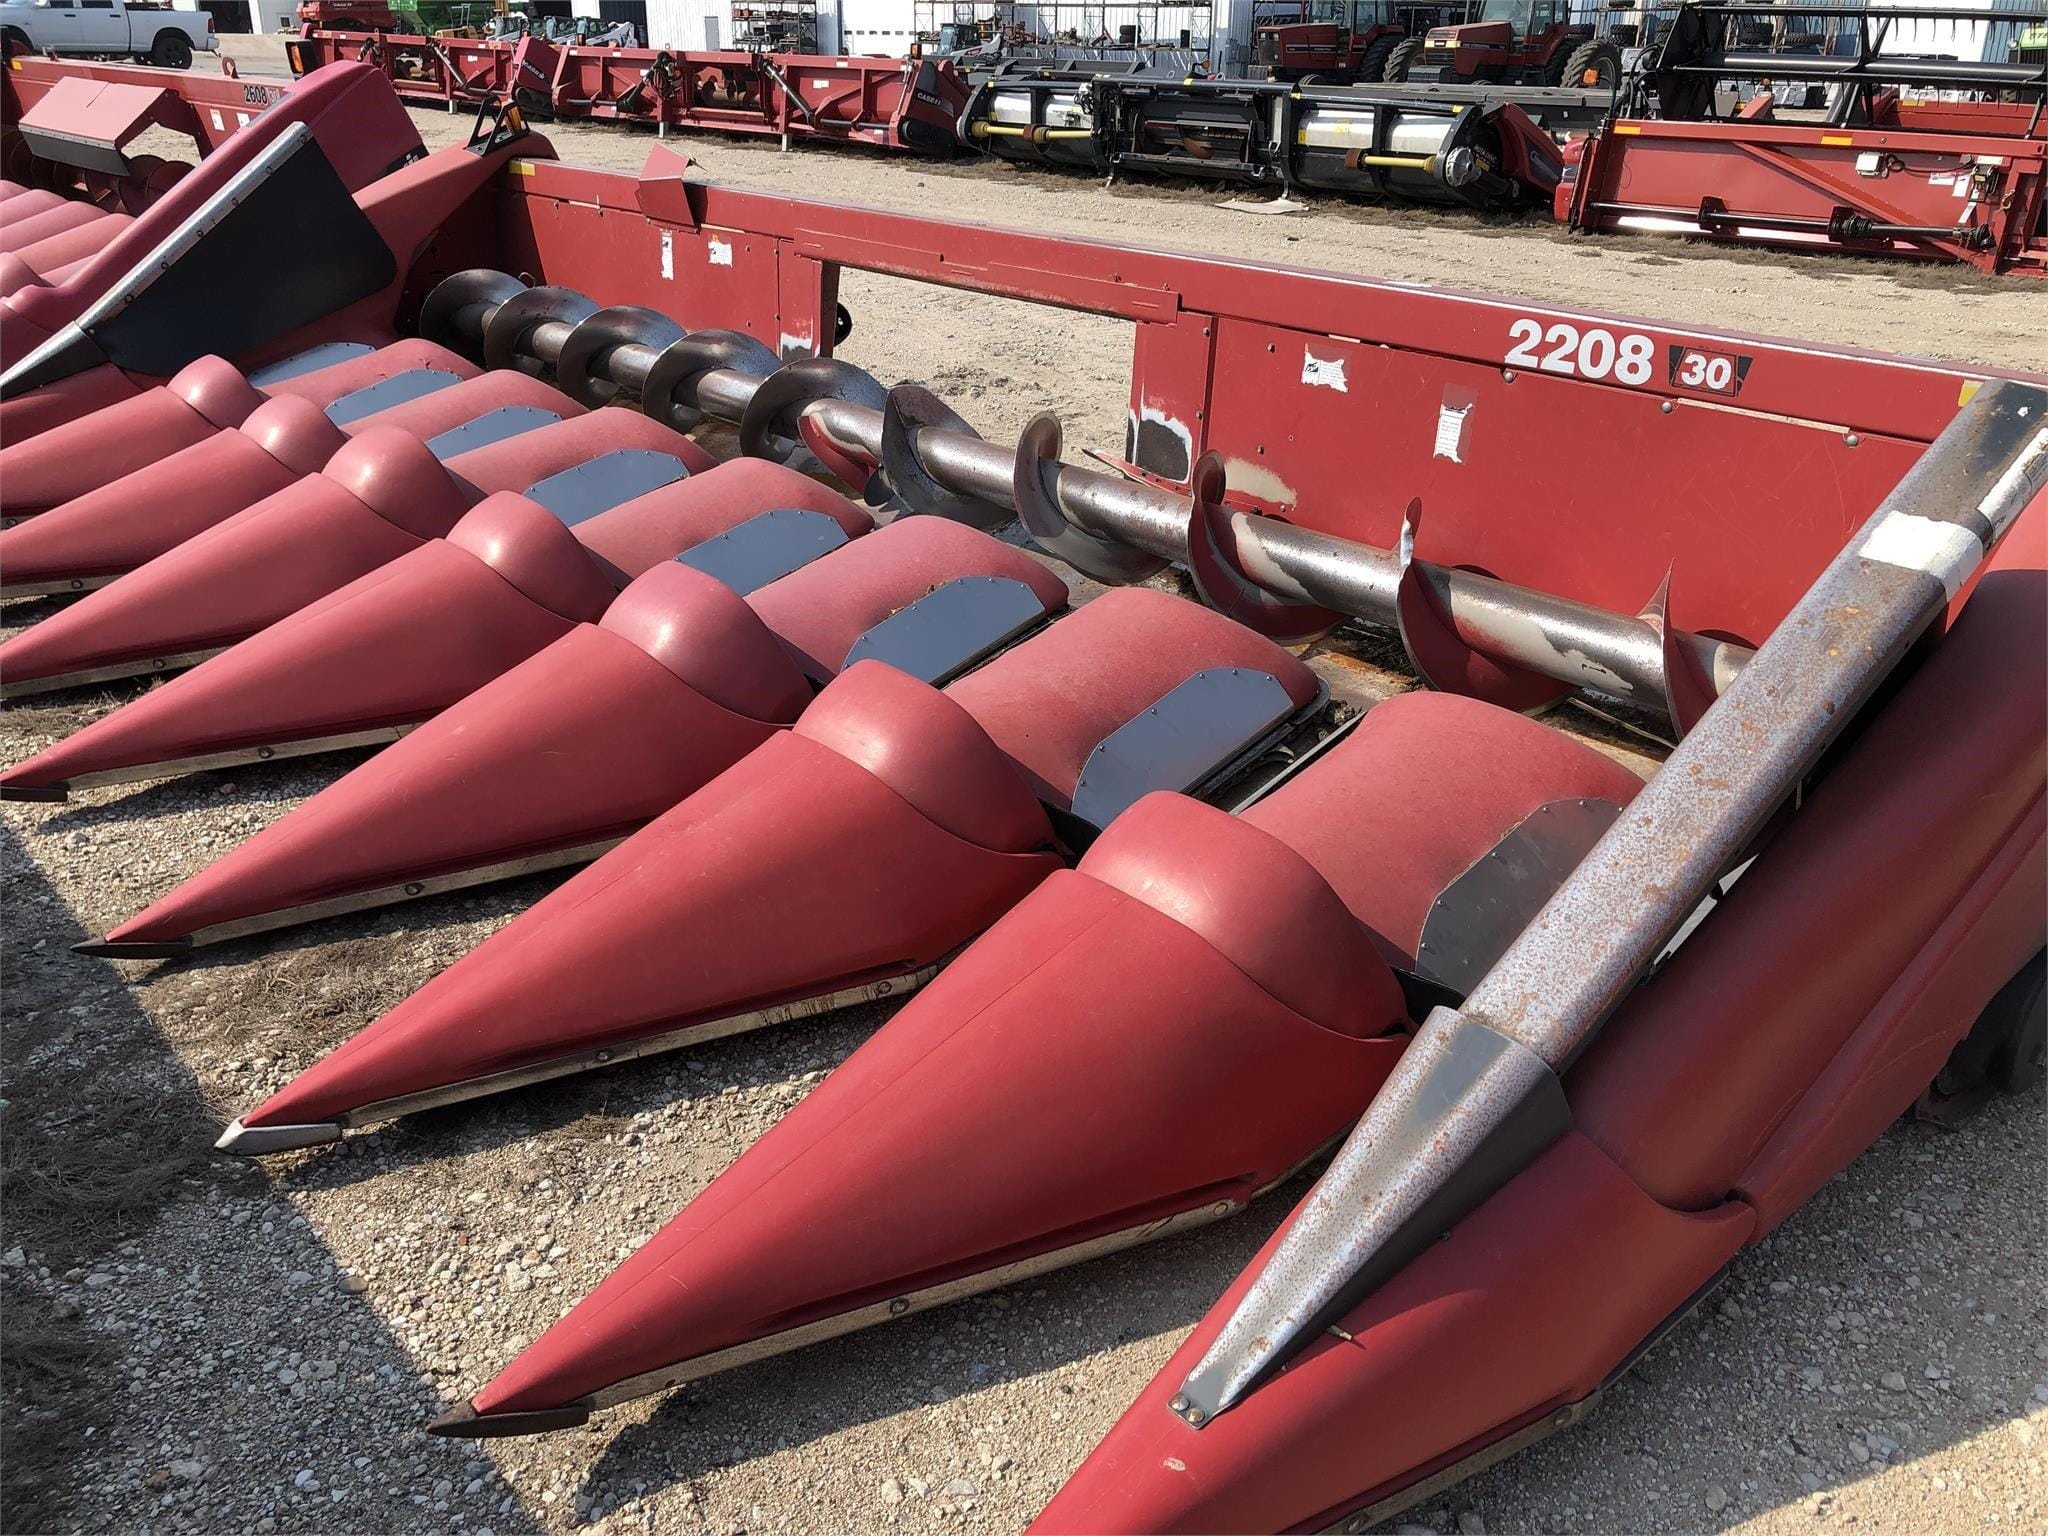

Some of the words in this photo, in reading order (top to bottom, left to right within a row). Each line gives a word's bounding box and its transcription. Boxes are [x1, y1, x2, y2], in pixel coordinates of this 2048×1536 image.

[244, 84, 268, 105] 2608
[917, 92, 934, 104] CASE
[1504, 318, 1655, 386] 2208
[1680, 353, 1733, 391] 30
